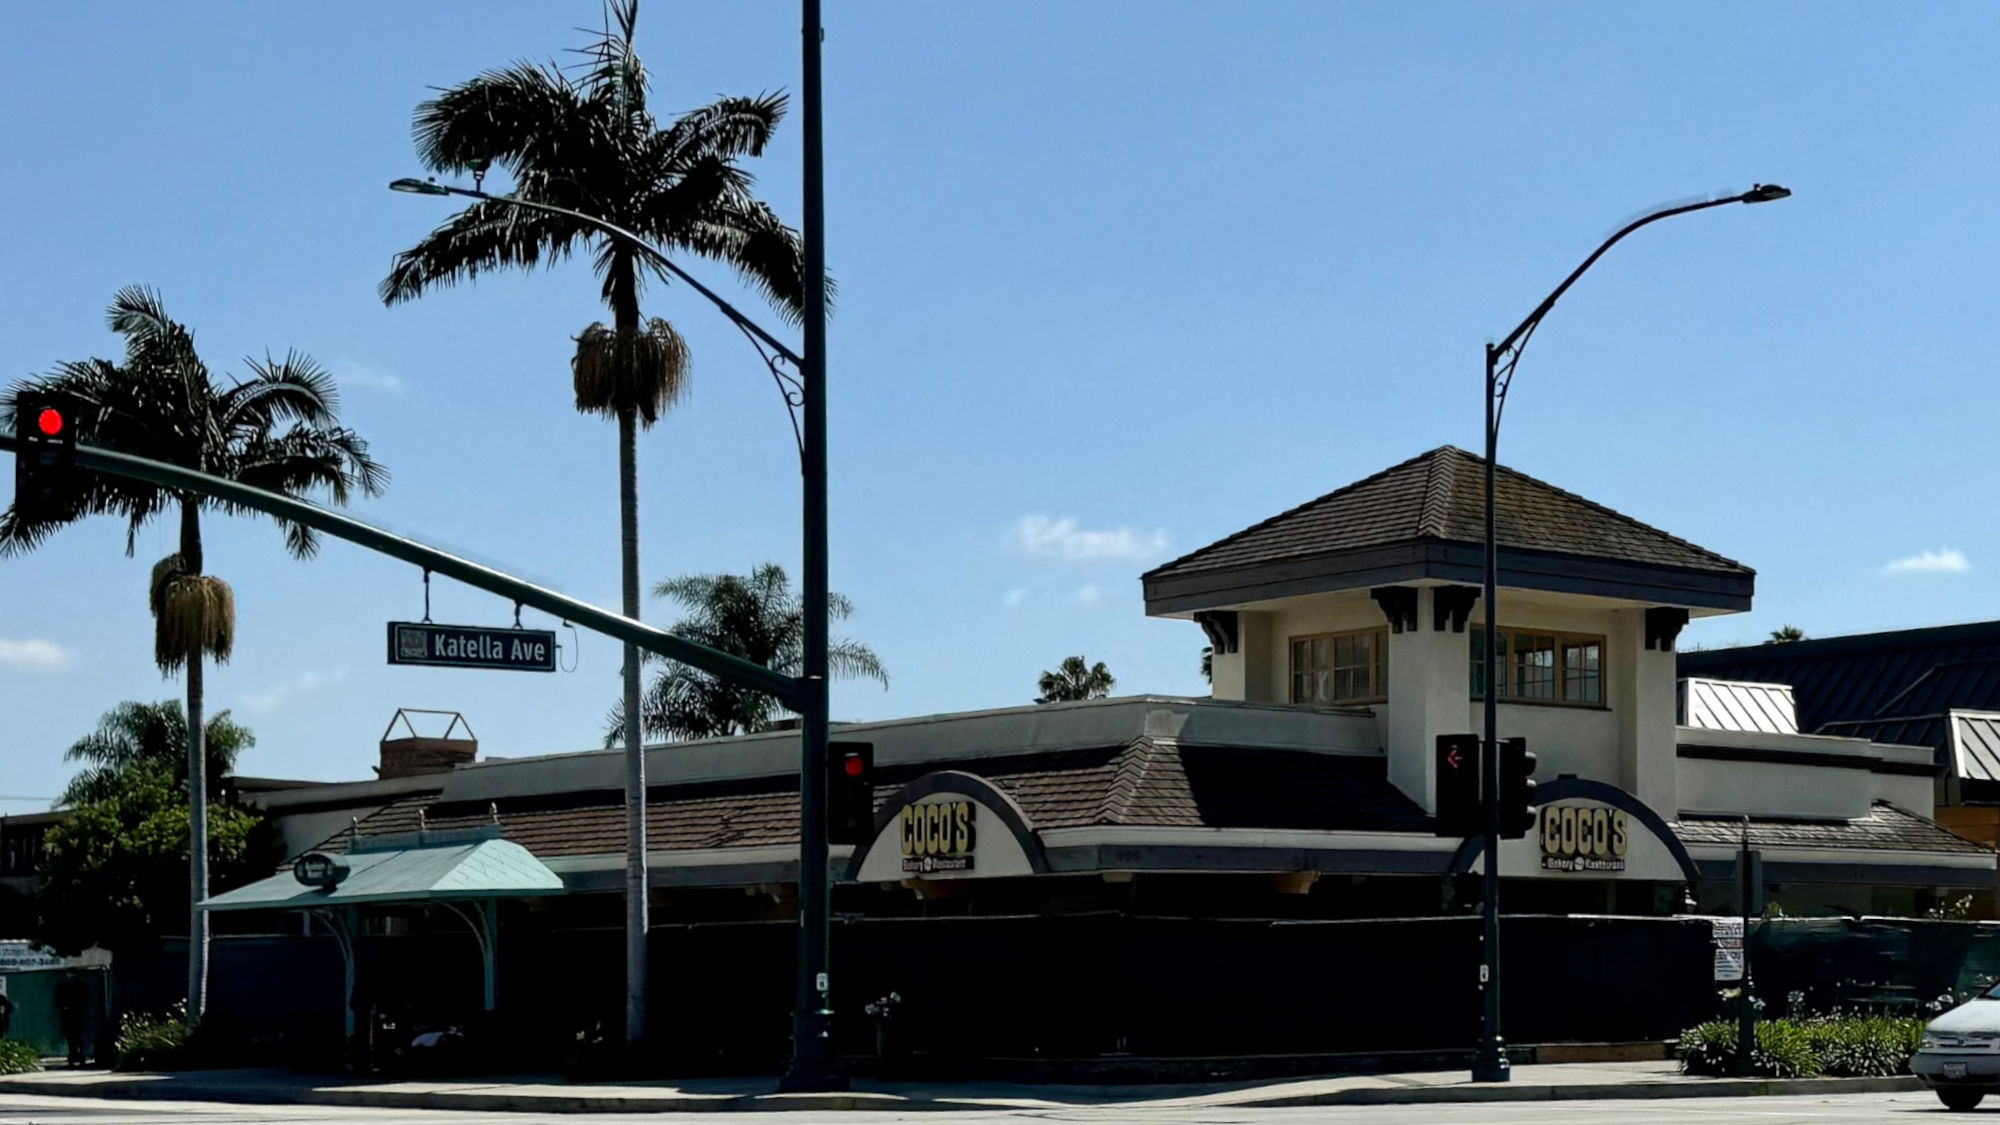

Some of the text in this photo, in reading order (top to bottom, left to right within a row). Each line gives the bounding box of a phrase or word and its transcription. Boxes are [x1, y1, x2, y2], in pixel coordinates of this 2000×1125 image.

[435, 633, 503, 660] Katella
[511, 638, 545, 662] Ave
[902, 802, 970, 856] COCO'S
[1543, 806, 1627, 856] COCO'S
